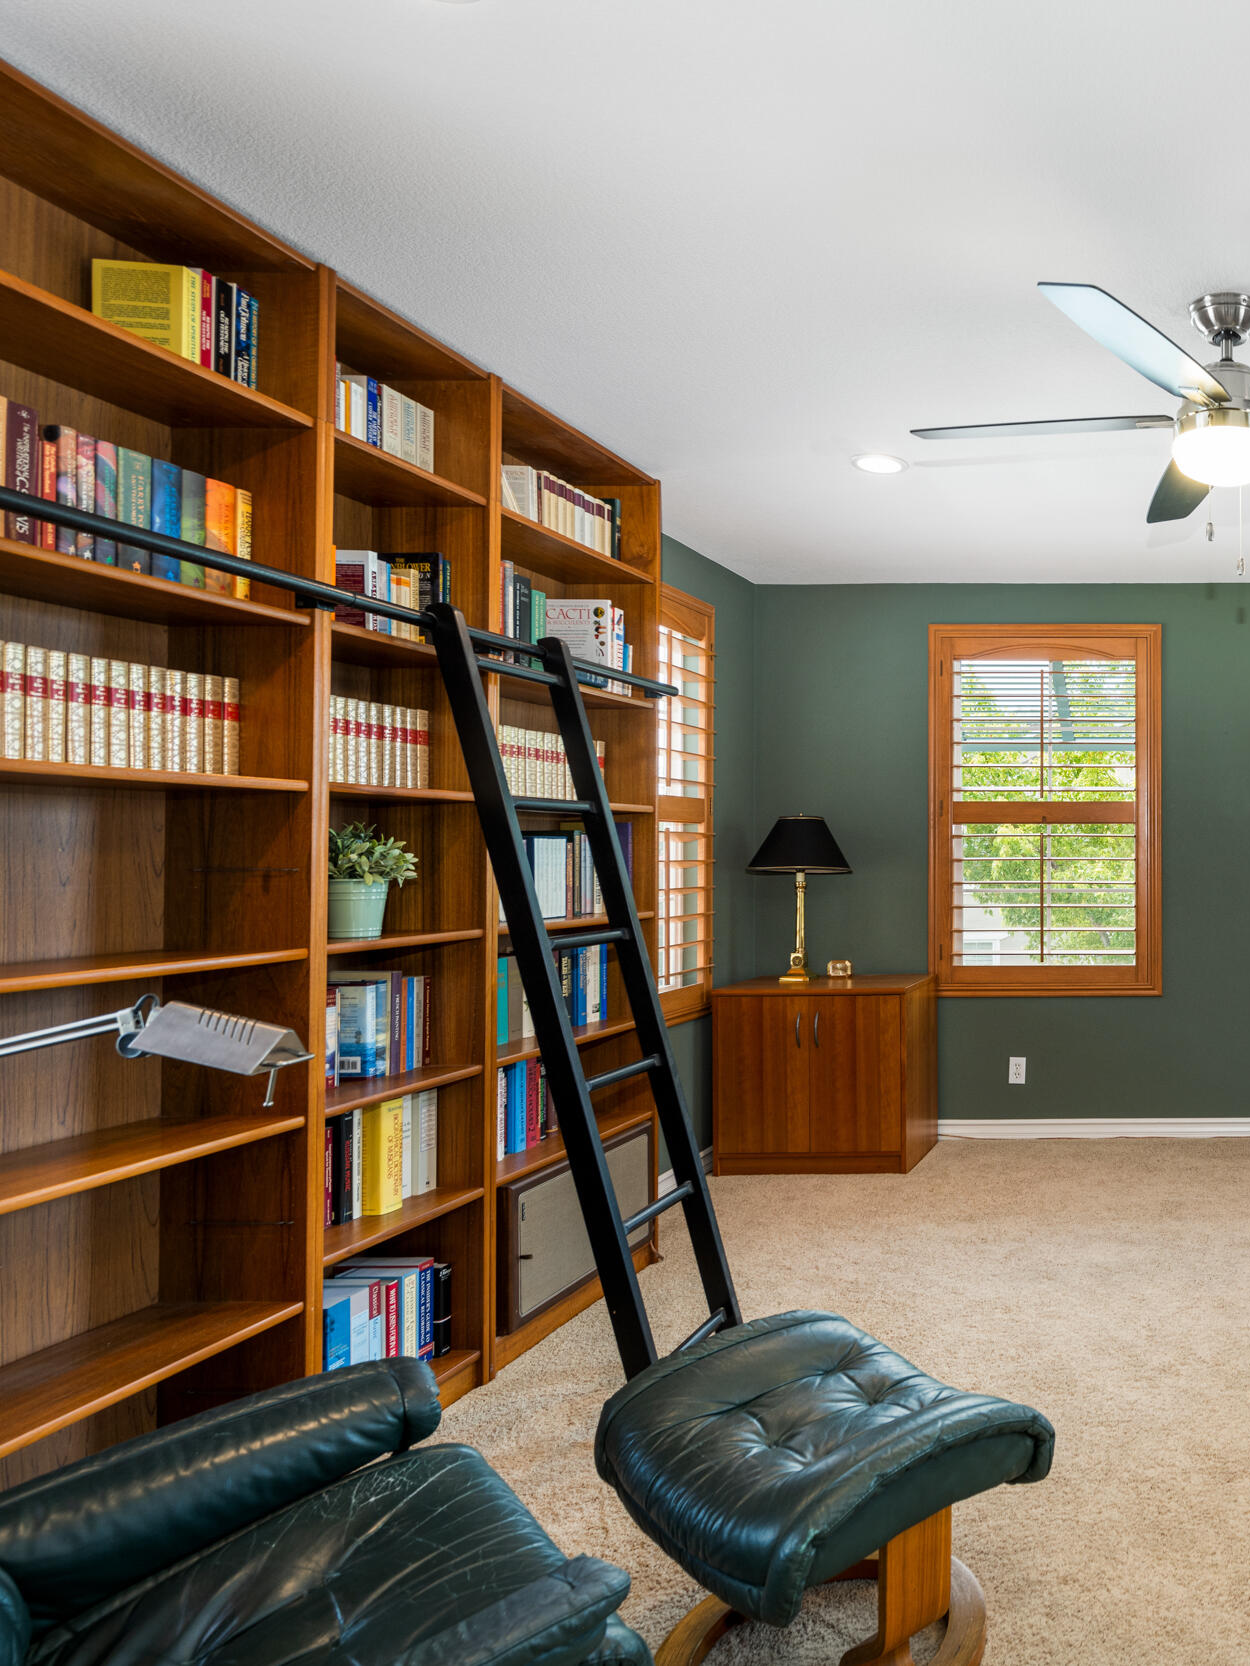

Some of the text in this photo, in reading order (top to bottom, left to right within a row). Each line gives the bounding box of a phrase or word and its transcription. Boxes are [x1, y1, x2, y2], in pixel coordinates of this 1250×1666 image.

[546, 608, 591, 620] CACTI
[387, 1135, 393, 1143] OF
[426, 1334, 431, 1343] TO
